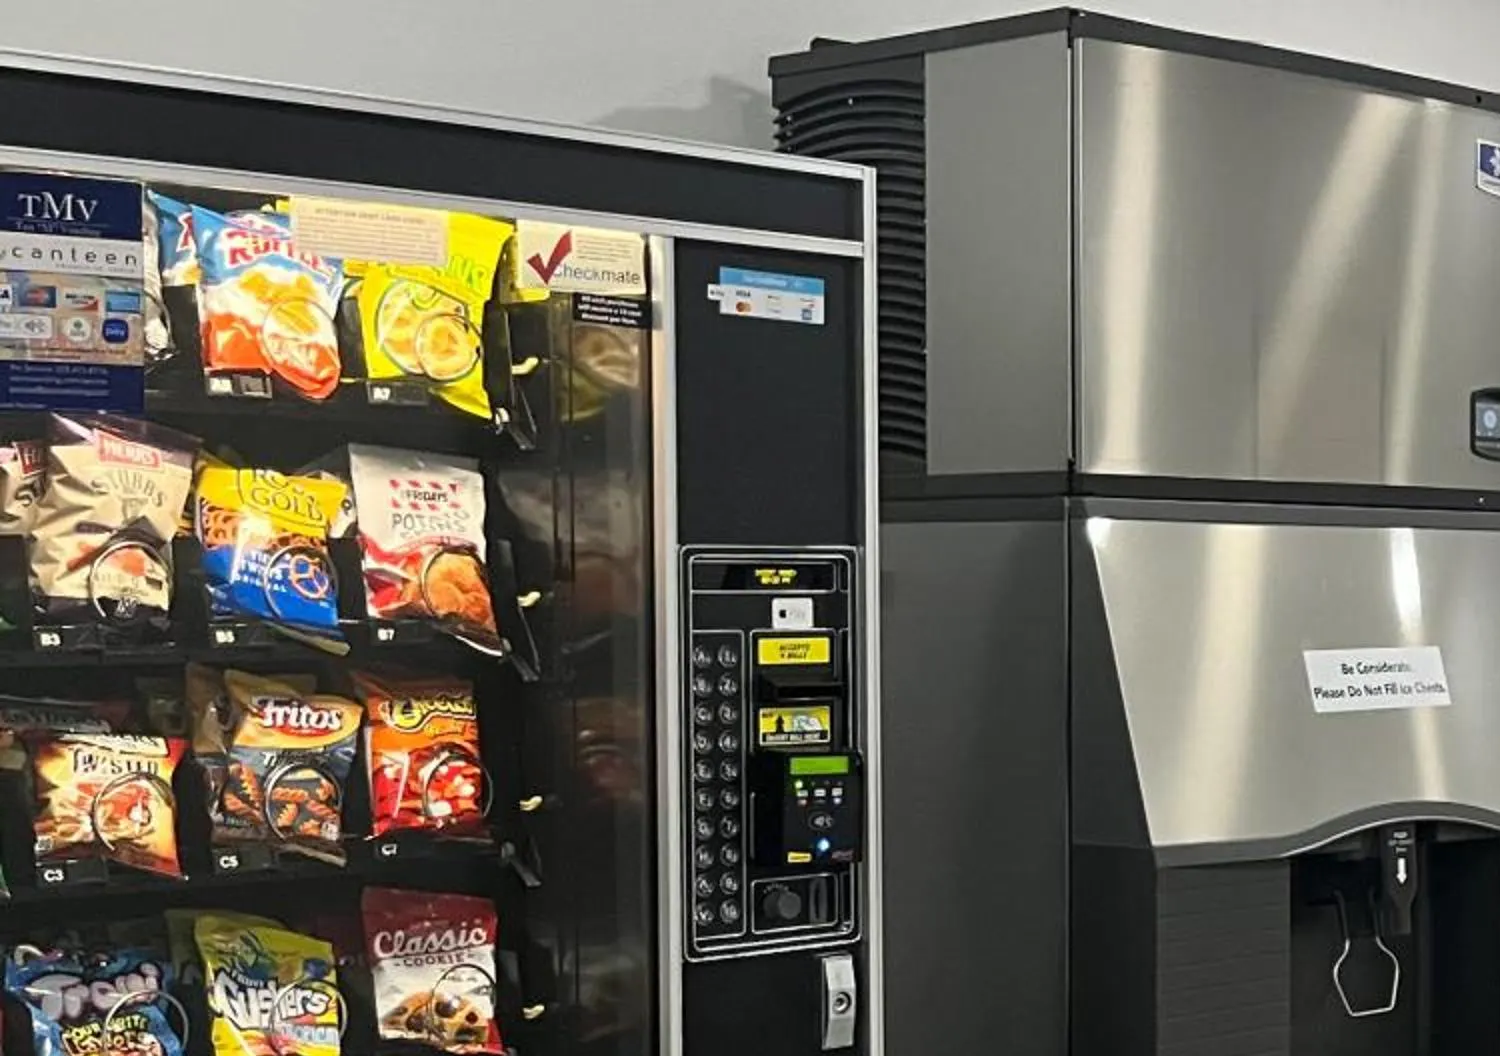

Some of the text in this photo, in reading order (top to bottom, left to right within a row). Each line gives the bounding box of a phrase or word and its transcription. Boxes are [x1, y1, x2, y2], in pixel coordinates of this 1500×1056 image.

[12, 246, 137, 266] canteen
[1341, 663, 1354, 675] Be
[1314, 687, 1345, 699] Please
[1347, 685, 1362, 697] Do
[1364, 684, 1382, 696] Not
[1384, 682, 1398, 695] Fill
[44, 864, 64, 881] C3
